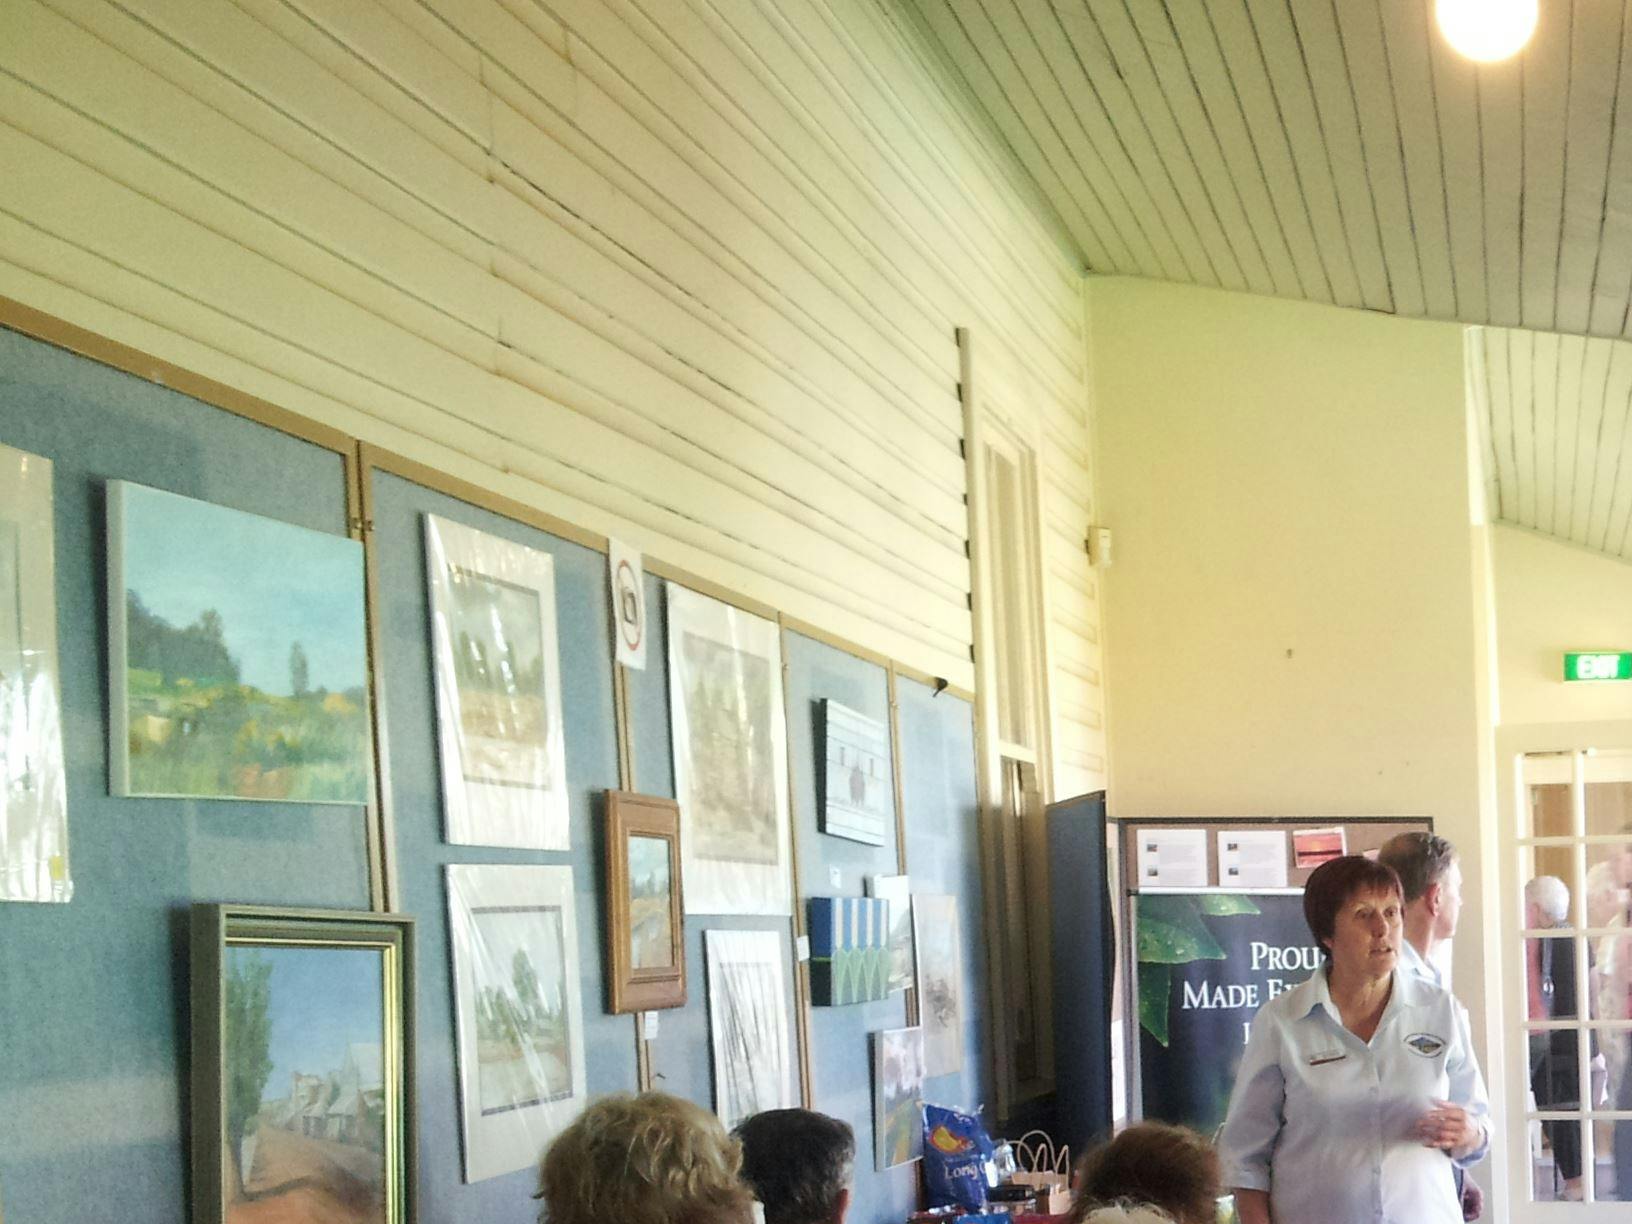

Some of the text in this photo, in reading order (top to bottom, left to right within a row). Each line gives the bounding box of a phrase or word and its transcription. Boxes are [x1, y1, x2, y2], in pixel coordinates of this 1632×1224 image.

[1577, 654, 1618, 679] EXIT
[1250, 941, 1321, 971] PROU
[1181, 980, 1260, 1010] MADE
[943, 1164, 978, 1180] Long
